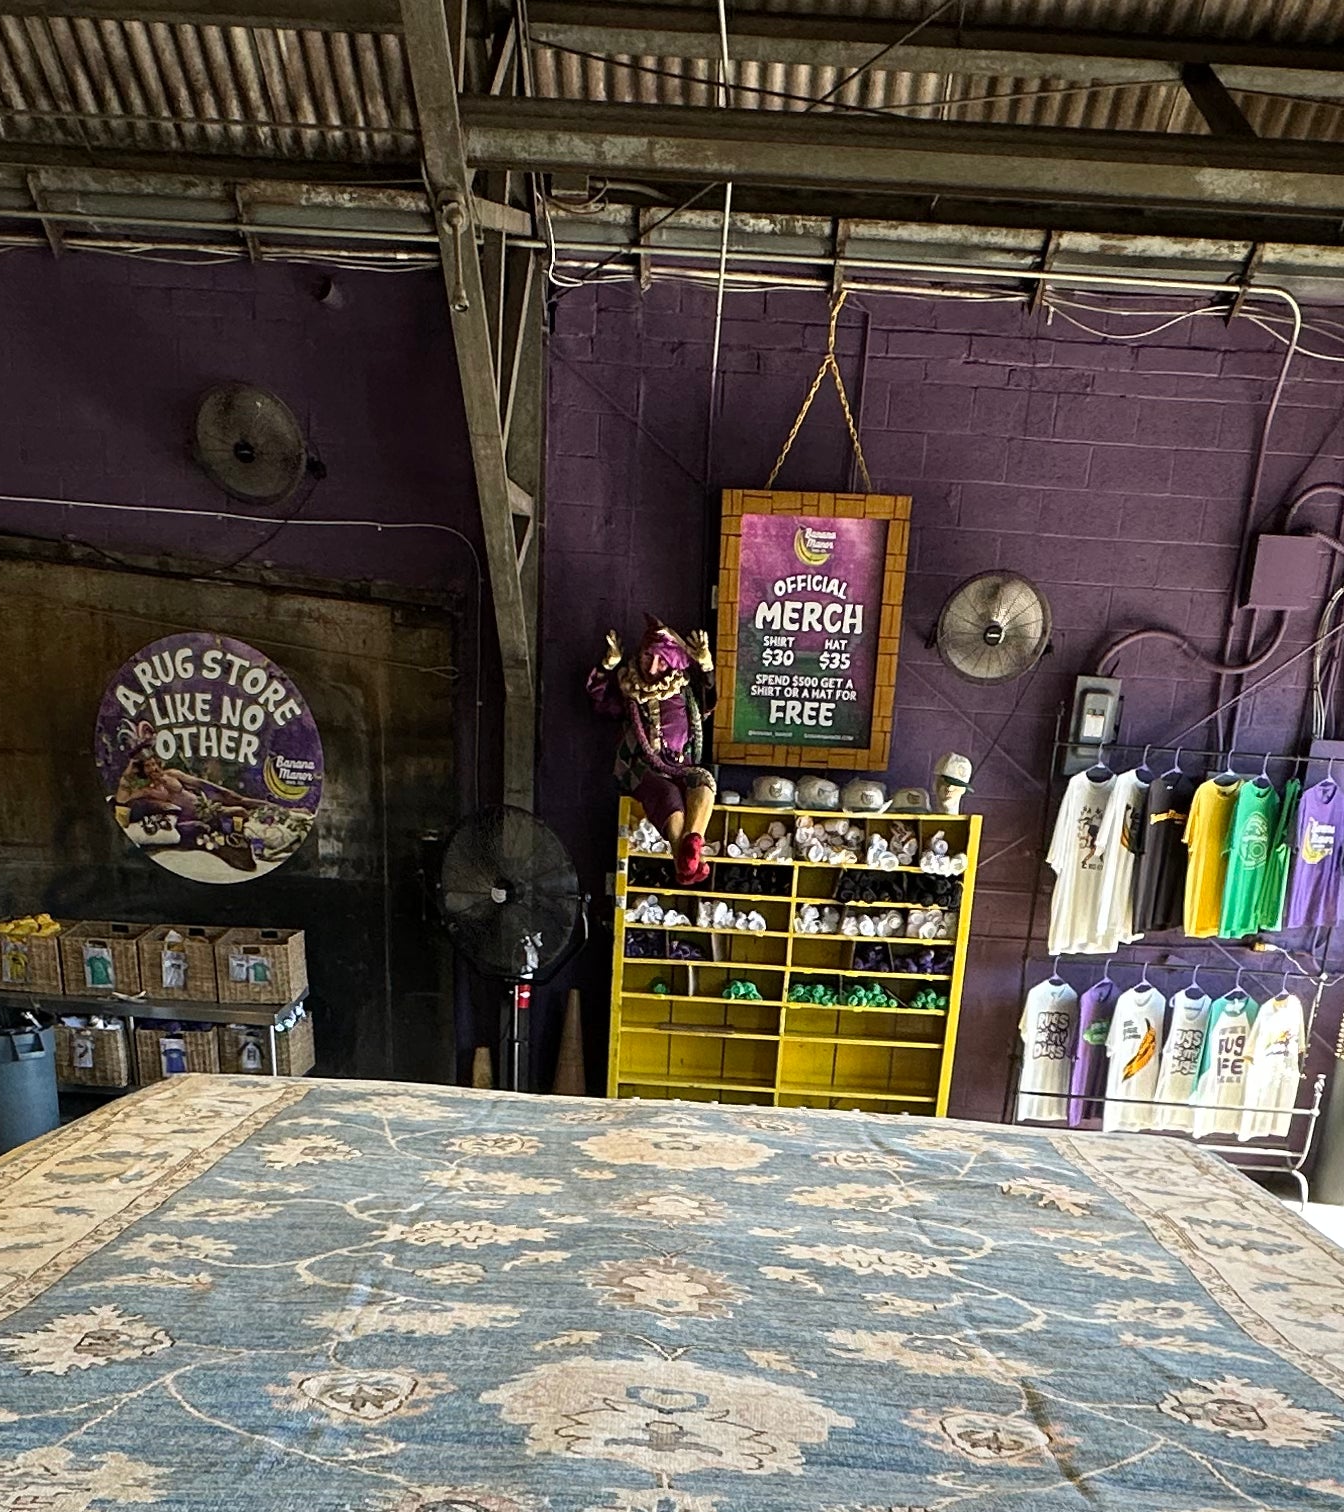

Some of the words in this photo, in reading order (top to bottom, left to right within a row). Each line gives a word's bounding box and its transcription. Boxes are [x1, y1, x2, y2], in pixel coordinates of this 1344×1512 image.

[773, 574, 848, 600] OFFICIAL
[755, 601, 864, 635] MERCH
[763, 636, 796, 648] SHIRT
[824, 638, 849, 650] HAT
[761, 648, 794, 667] $30
[819, 652, 851, 670] $35
[115, 685, 145, 716] A
[134, 647, 195, 695] RUG
[201, 649, 302, 727] STORE
[755, 673, 791, 686] SPEND
[792, 675, 819, 687] $500
[820, 678, 844, 689] GET
[845, 679, 854, 690] A
[750, 685, 782, 697] SHIRT
[783, 687, 800, 698] OR
[801, 688, 810, 699] A
[811, 688, 835, 700] HAT
[835, 690, 857, 701] FOR
[149, 692, 213, 727] LIKE
[220, 697, 265, 732] NO
[768, 699, 836, 727] FREE
[154, 727, 261, 767] OTHER
[275, 755, 315, 770] Banana
[278, 768, 314, 781] Manor
